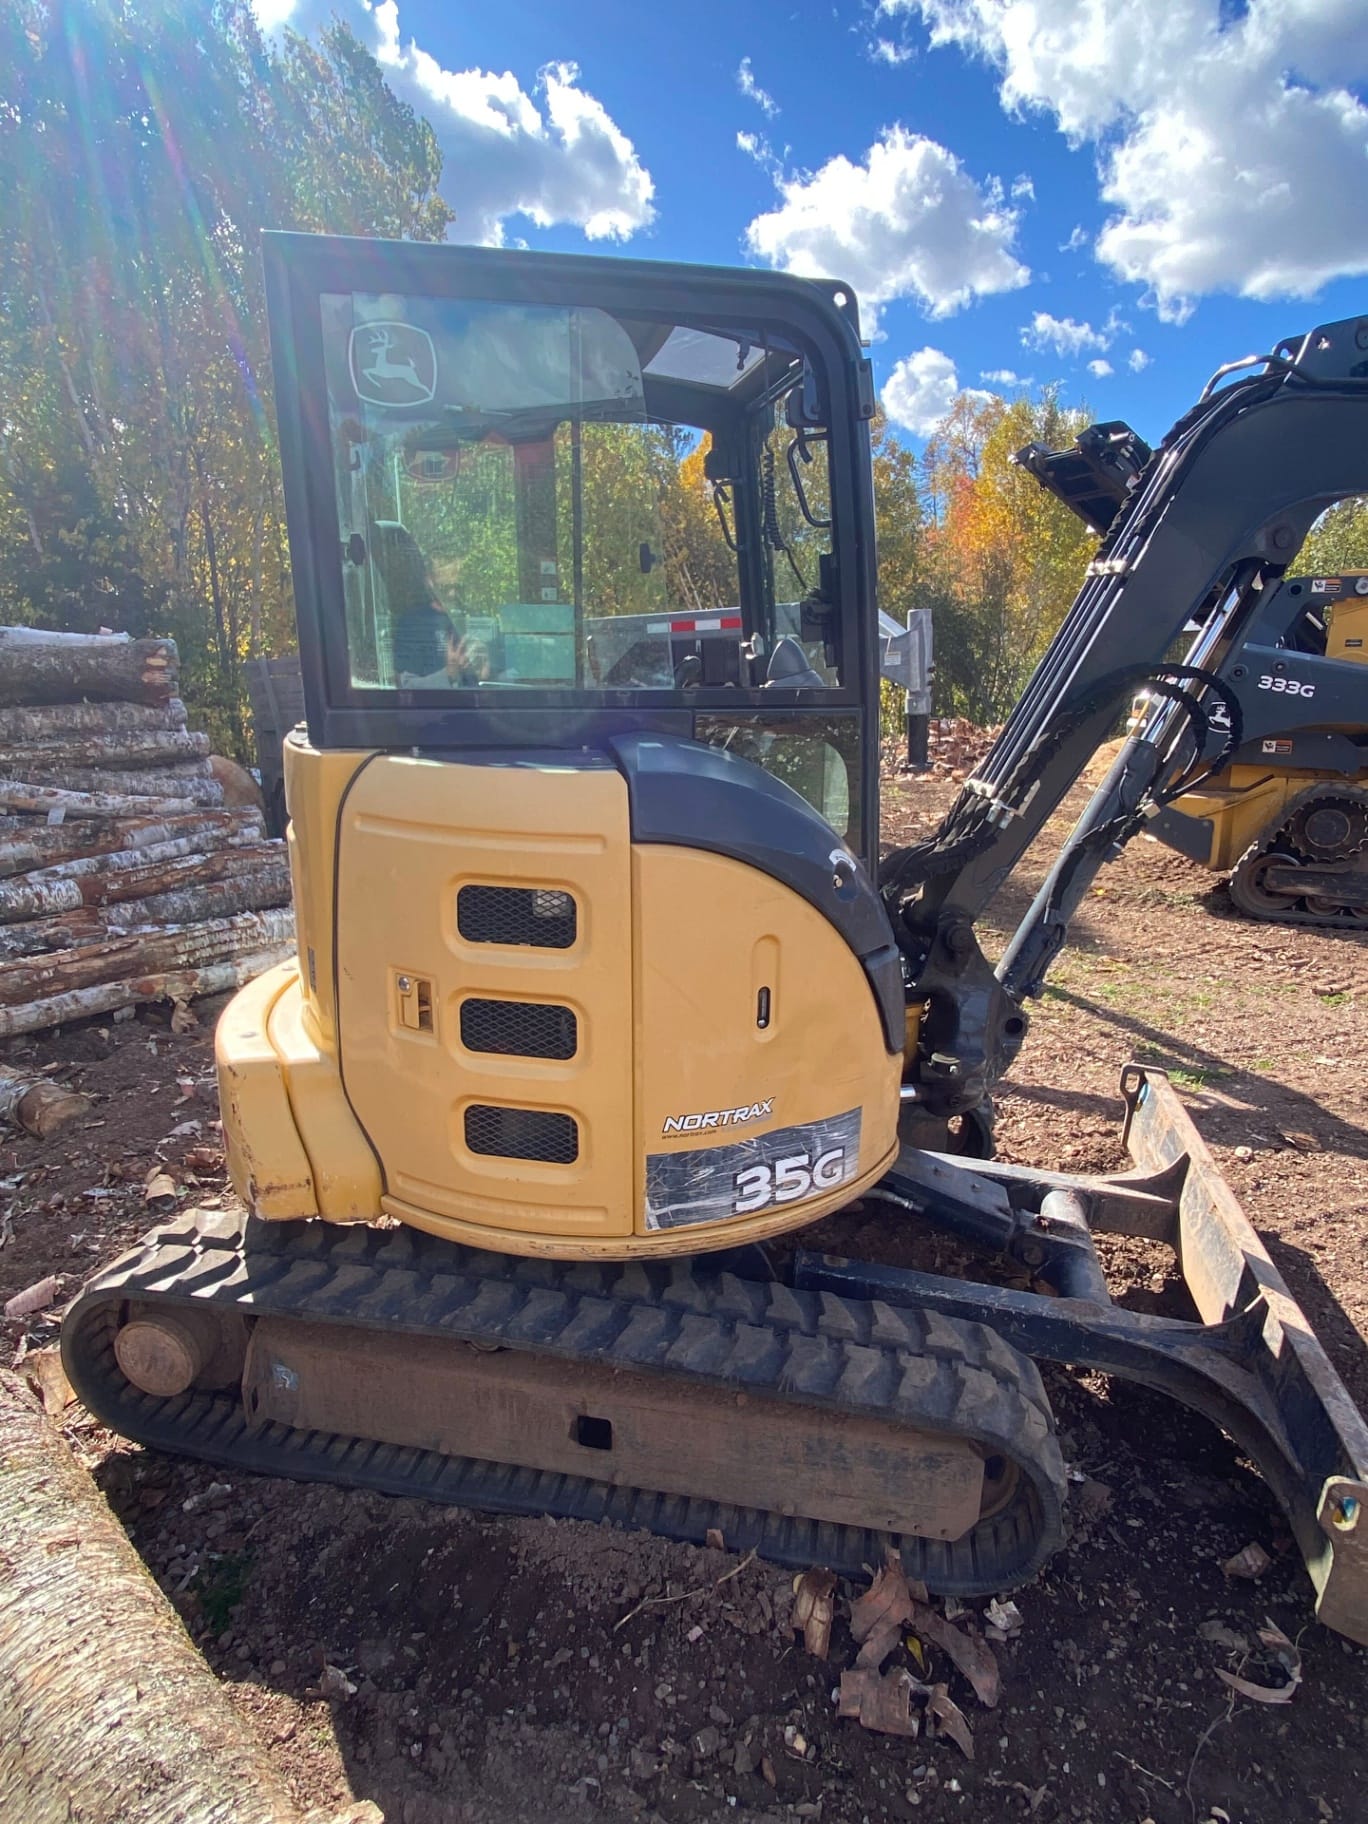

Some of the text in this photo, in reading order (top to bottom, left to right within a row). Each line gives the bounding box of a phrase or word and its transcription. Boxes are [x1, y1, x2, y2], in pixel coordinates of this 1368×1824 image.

[1257, 675, 1316, 698] 333G
[662, 1096, 776, 1133] NORTRAX
[734, 1148, 846, 1212] 35G
